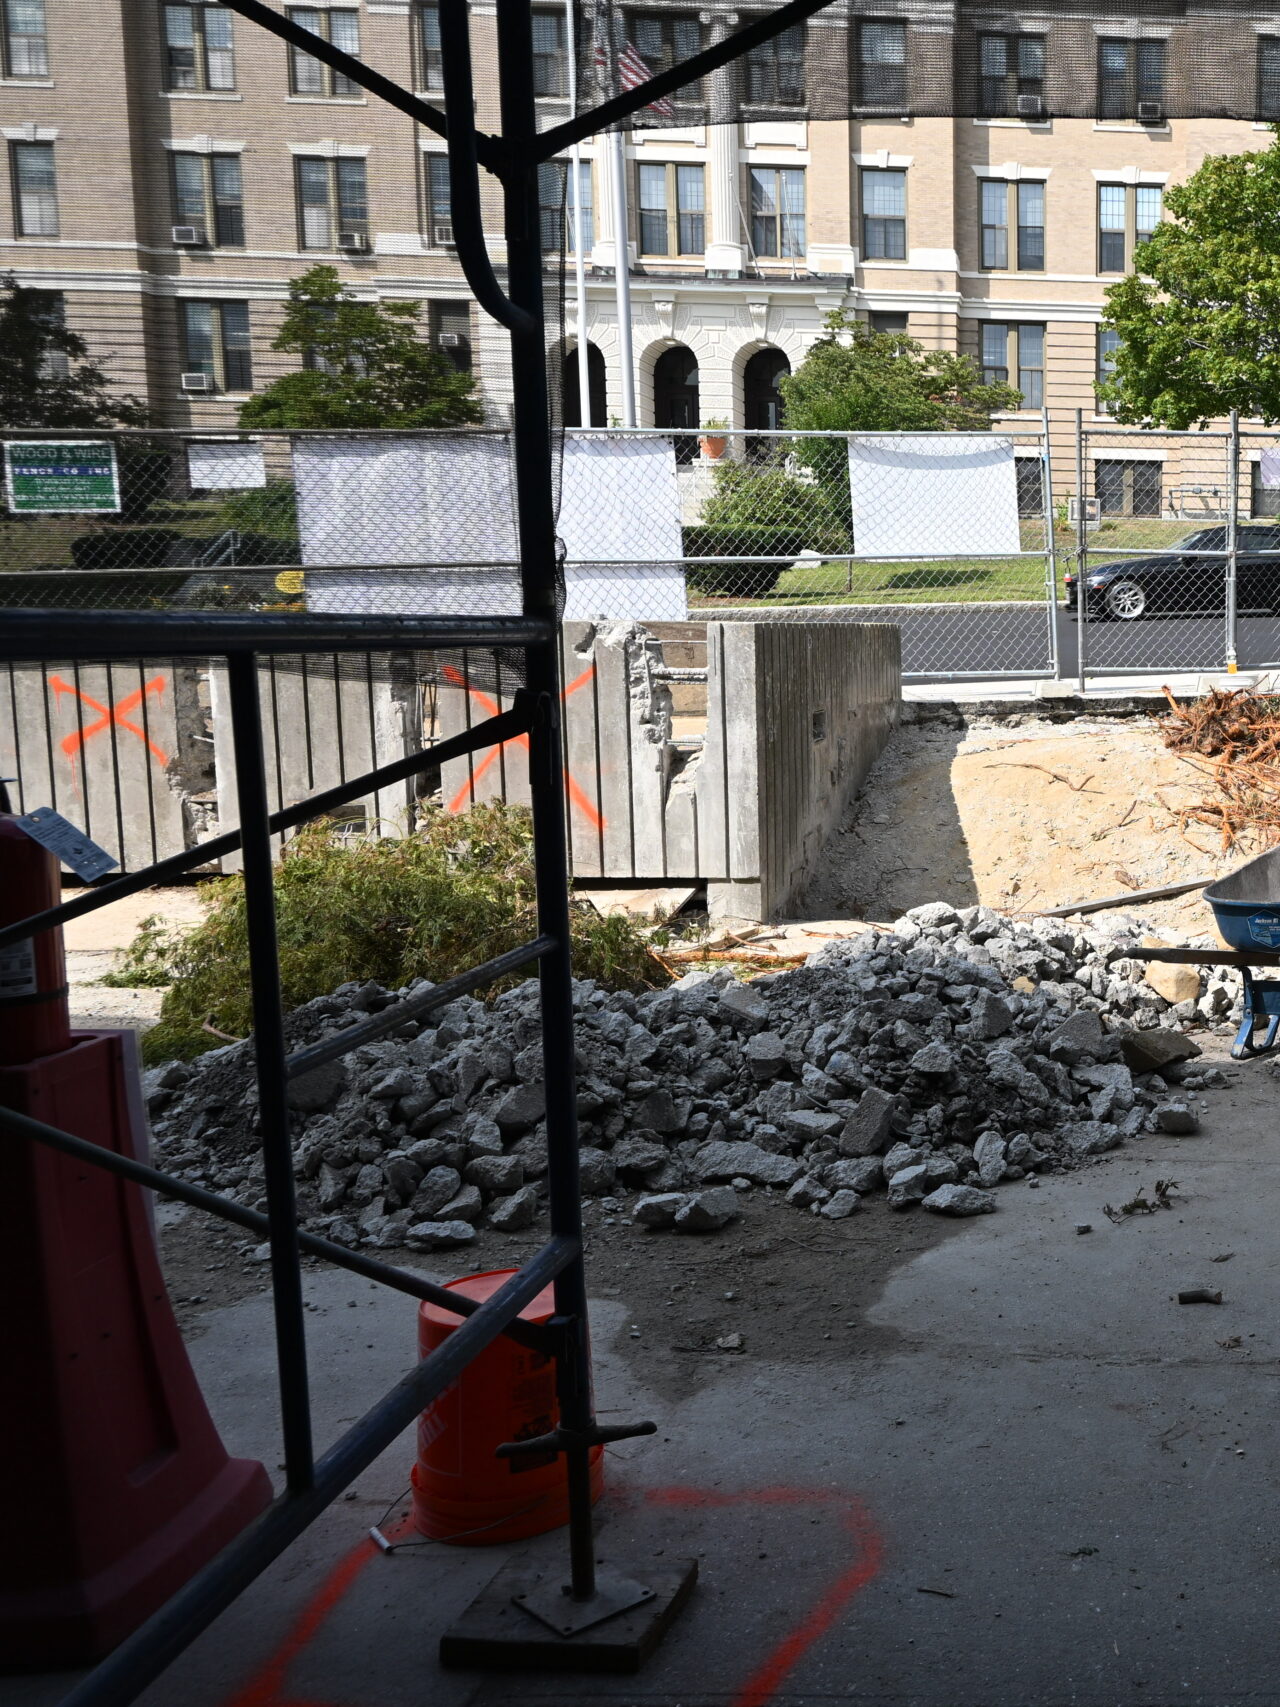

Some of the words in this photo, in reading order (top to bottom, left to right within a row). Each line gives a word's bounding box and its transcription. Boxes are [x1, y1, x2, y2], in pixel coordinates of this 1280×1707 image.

[12, 447, 57, 459] WOOD
[62, 447, 72, 459] &
[74, 447, 110, 459] WIRE
[14, 467, 54, 475] FENCE
[63, 467, 78, 475] CO
[89, 467, 110, 475] INC
